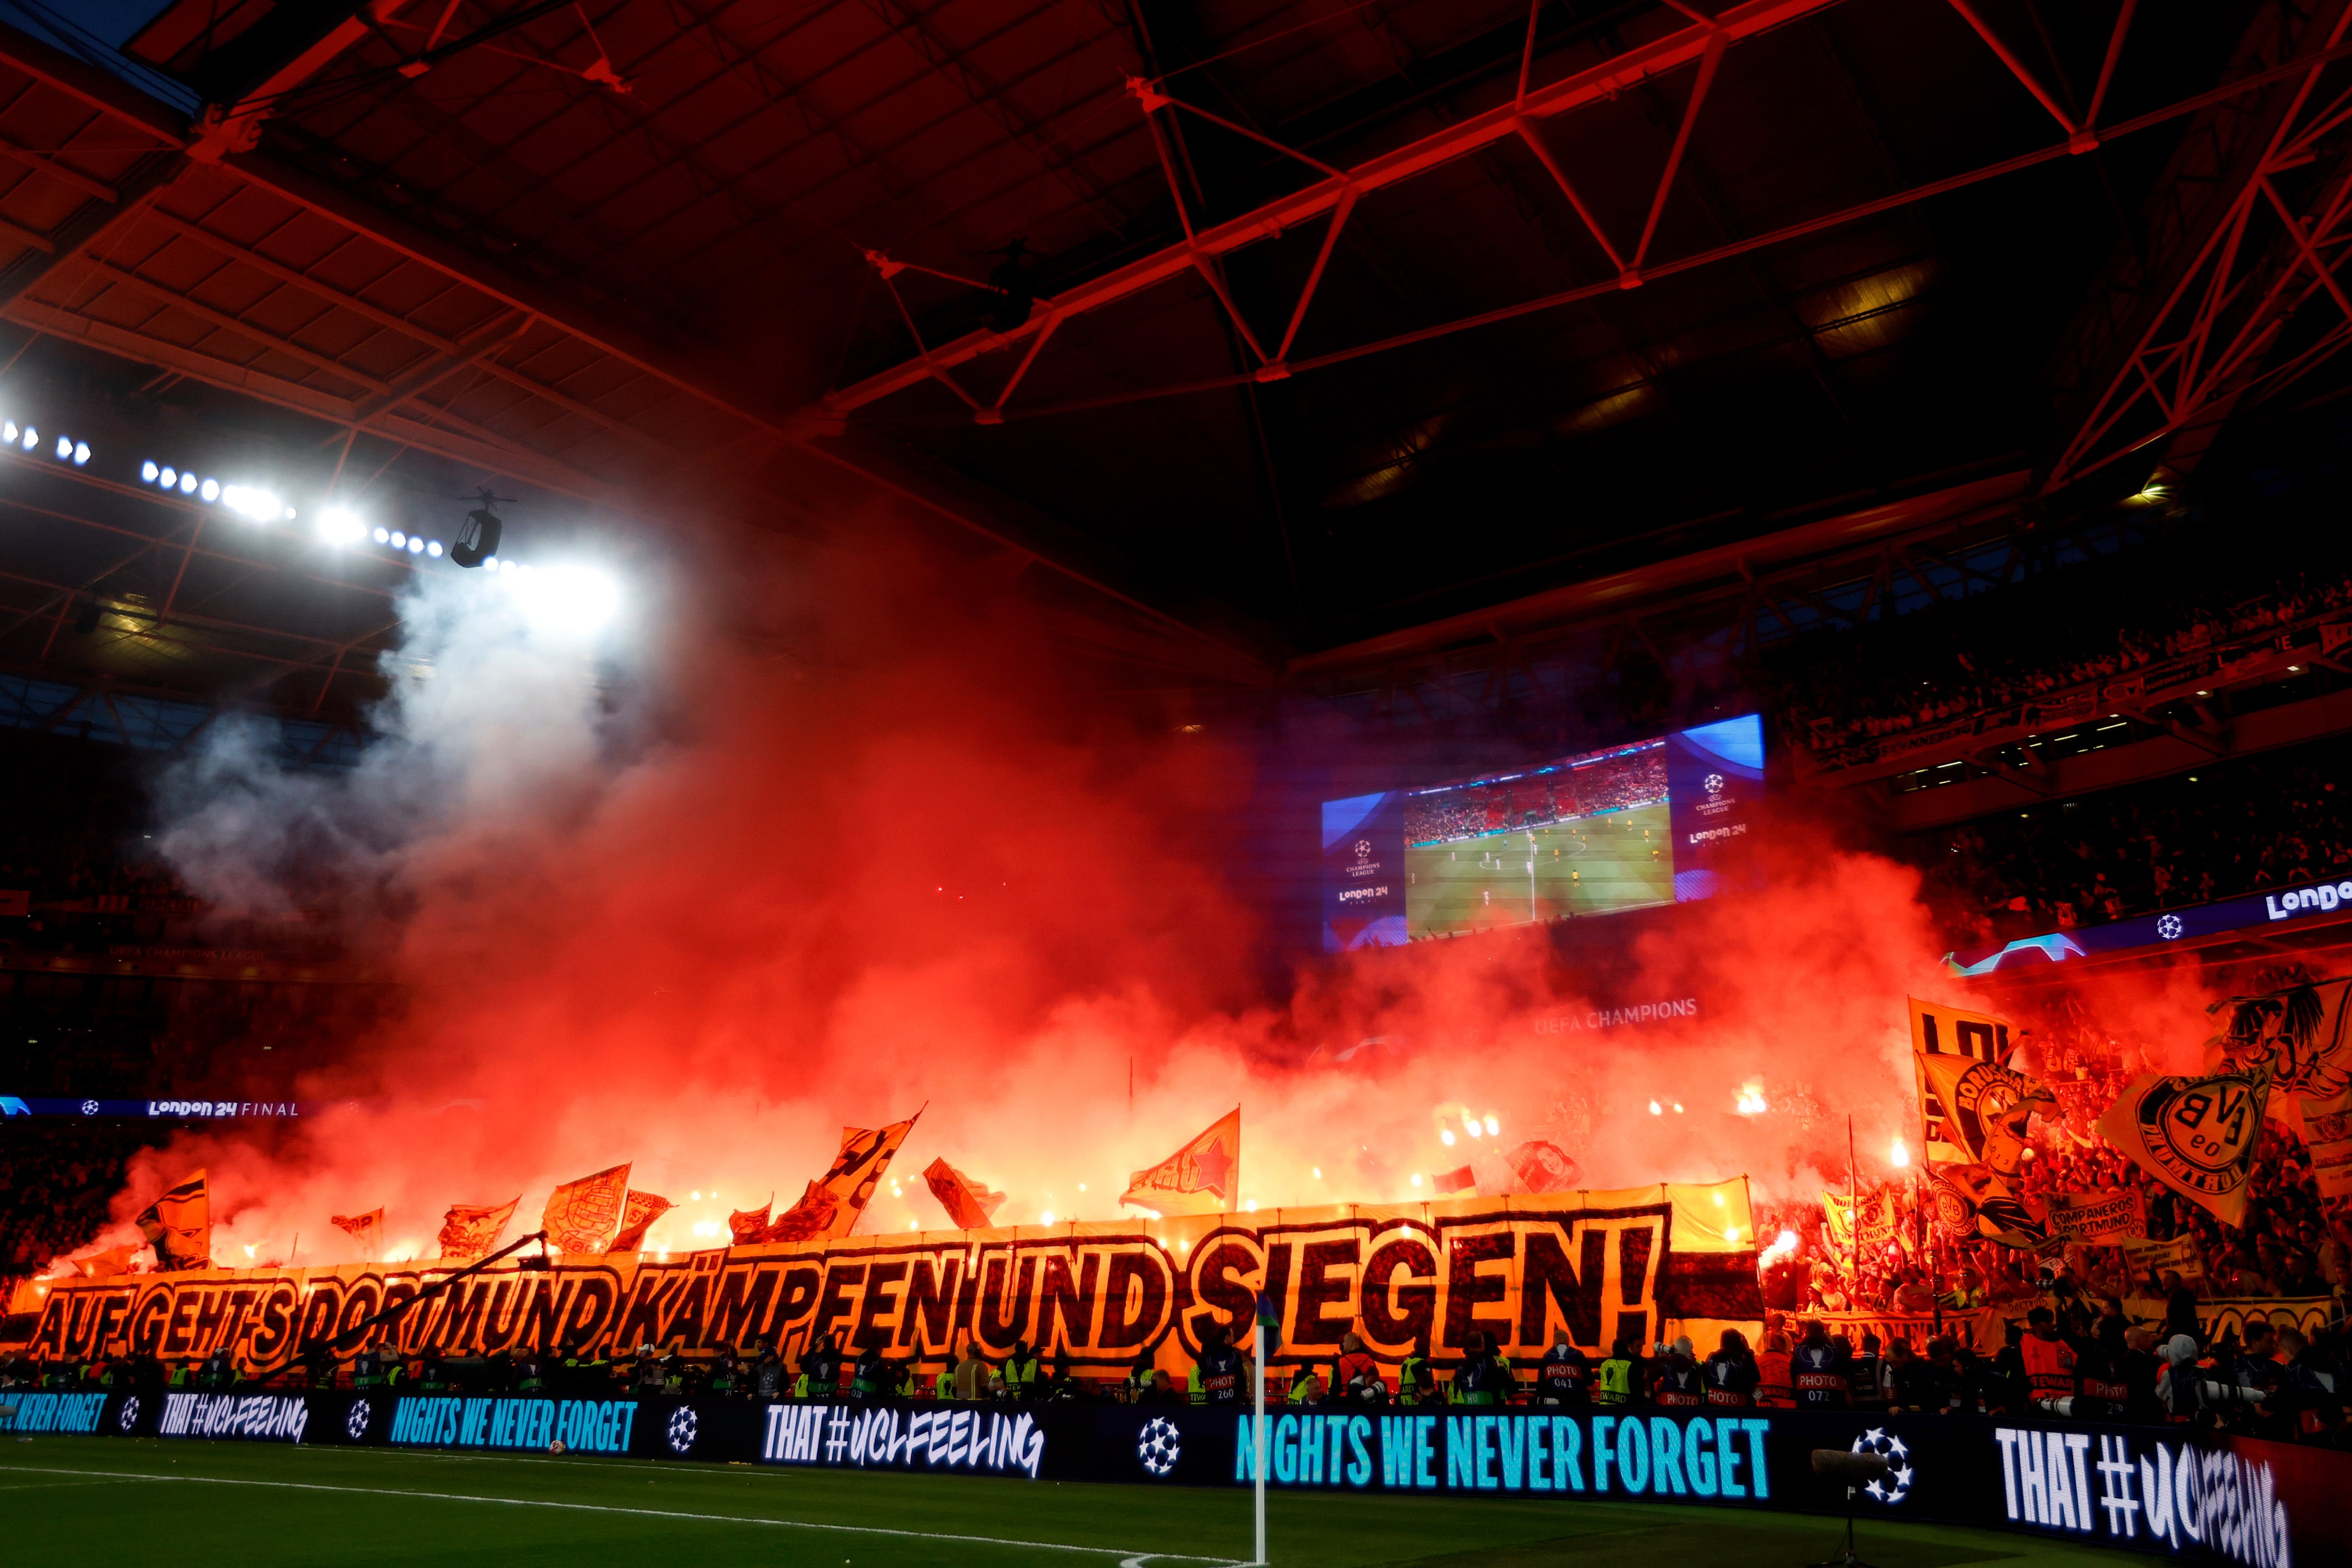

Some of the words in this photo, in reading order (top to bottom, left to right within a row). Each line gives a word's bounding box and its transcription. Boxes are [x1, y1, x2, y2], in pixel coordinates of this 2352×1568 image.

[1696, 799, 1736, 811] CHAMPIONS
[1704, 806, 1729, 816] LEAGUE
[1732, 824, 1746, 835] 24
[1346, 863, 1380, 872] CHAMPIONS
[1352, 869, 1374, 877] LEAGUE
[1376, 886, 1387, 896] 24
[1535, 1016, 1582, 1035] UEFA
[1586, 997, 1697, 1029] CHAMPIONS
[215, 1102, 237, 1117] 24
[242, 1103, 299, 1116] FINAL
[28, 1295, 129, 1358] AUF
[616, 1253, 962, 1350] KÄMPFEN
[978, 1251, 1166, 1349] UND
[1190, 1226, 1653, 1348] SIEGEN!
[1546, 1365, 1578, 1376] PHOTO
[856, 1378, 865, 1388] TV
[1554, 1378, 1573, 1388] 041
[1799, 1375, 1837, 1387] PHOTO
[1218, 1389, 1234, 1399] 260
[1467, 1393, 1478, 1403] HB
[1808, 1391, 1830, 1401] 072
[14, 1393, 58, 1431] NEVER
[52, 1393, 108, 1431] FORGET
[160, 1393, 199, 1434] THAT
[391, 1397, 461, 1445] NIGHTS
[459, 1398, 498, 1446] WE
[489, 1398, 556, 1448] NEVER
[553, 1399, 639, 1452] FORGET
[765, 1404, 828, 1460] THAT
[1236, 1414, 1372, 1485] NIGHTS
[1381, 1415, 1437, 1486] WE
[1446, 1416, 1585, 1491] NEVER
[1592, 1416, 1770, 1498] FORGET
[1995, 1427, 2092, 1531] THAT
